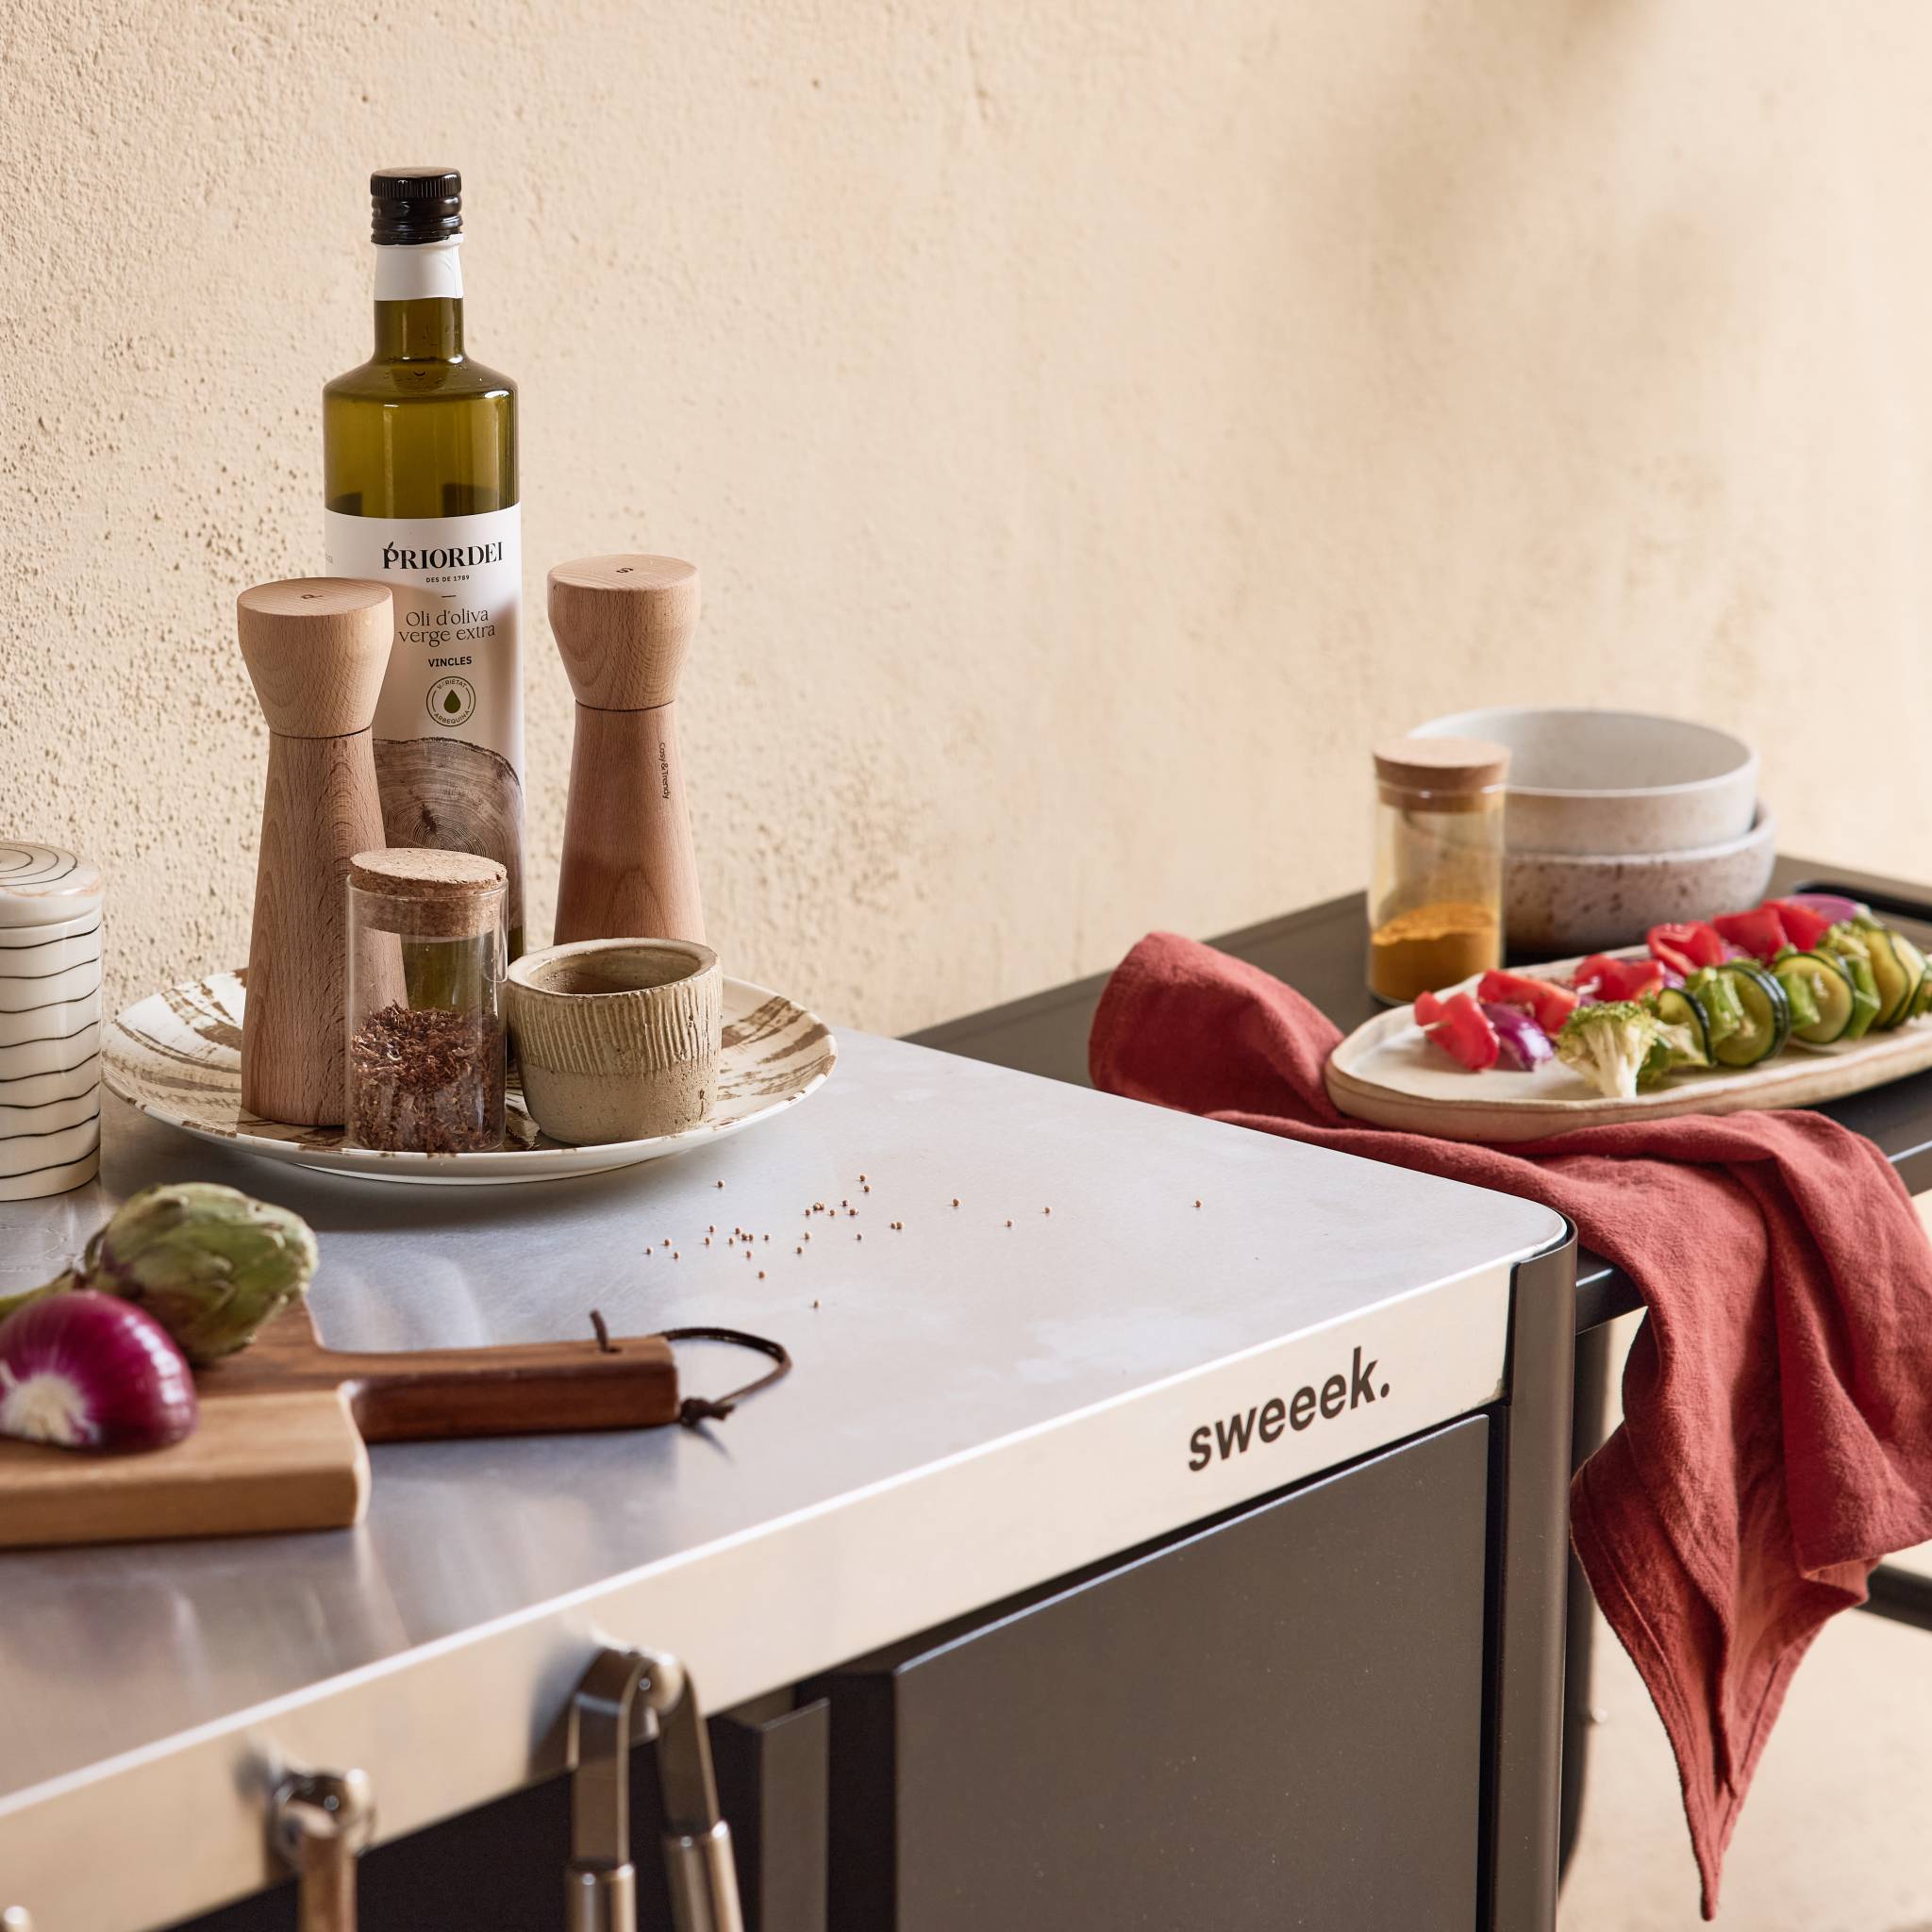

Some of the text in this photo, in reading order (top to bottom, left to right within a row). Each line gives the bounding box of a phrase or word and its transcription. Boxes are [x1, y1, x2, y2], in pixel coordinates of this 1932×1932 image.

[382, 541, 504, 570] PRIORDEI
[406, 608, 489, 627] Oli d'oliva
[398, 623, 496, 648] verge extra
[427, 656, 473, 668] VINCLES
[434, 709, 471, 724] ARBEQUINA
[1189, 1345, 1391, 1472] sweeek.
